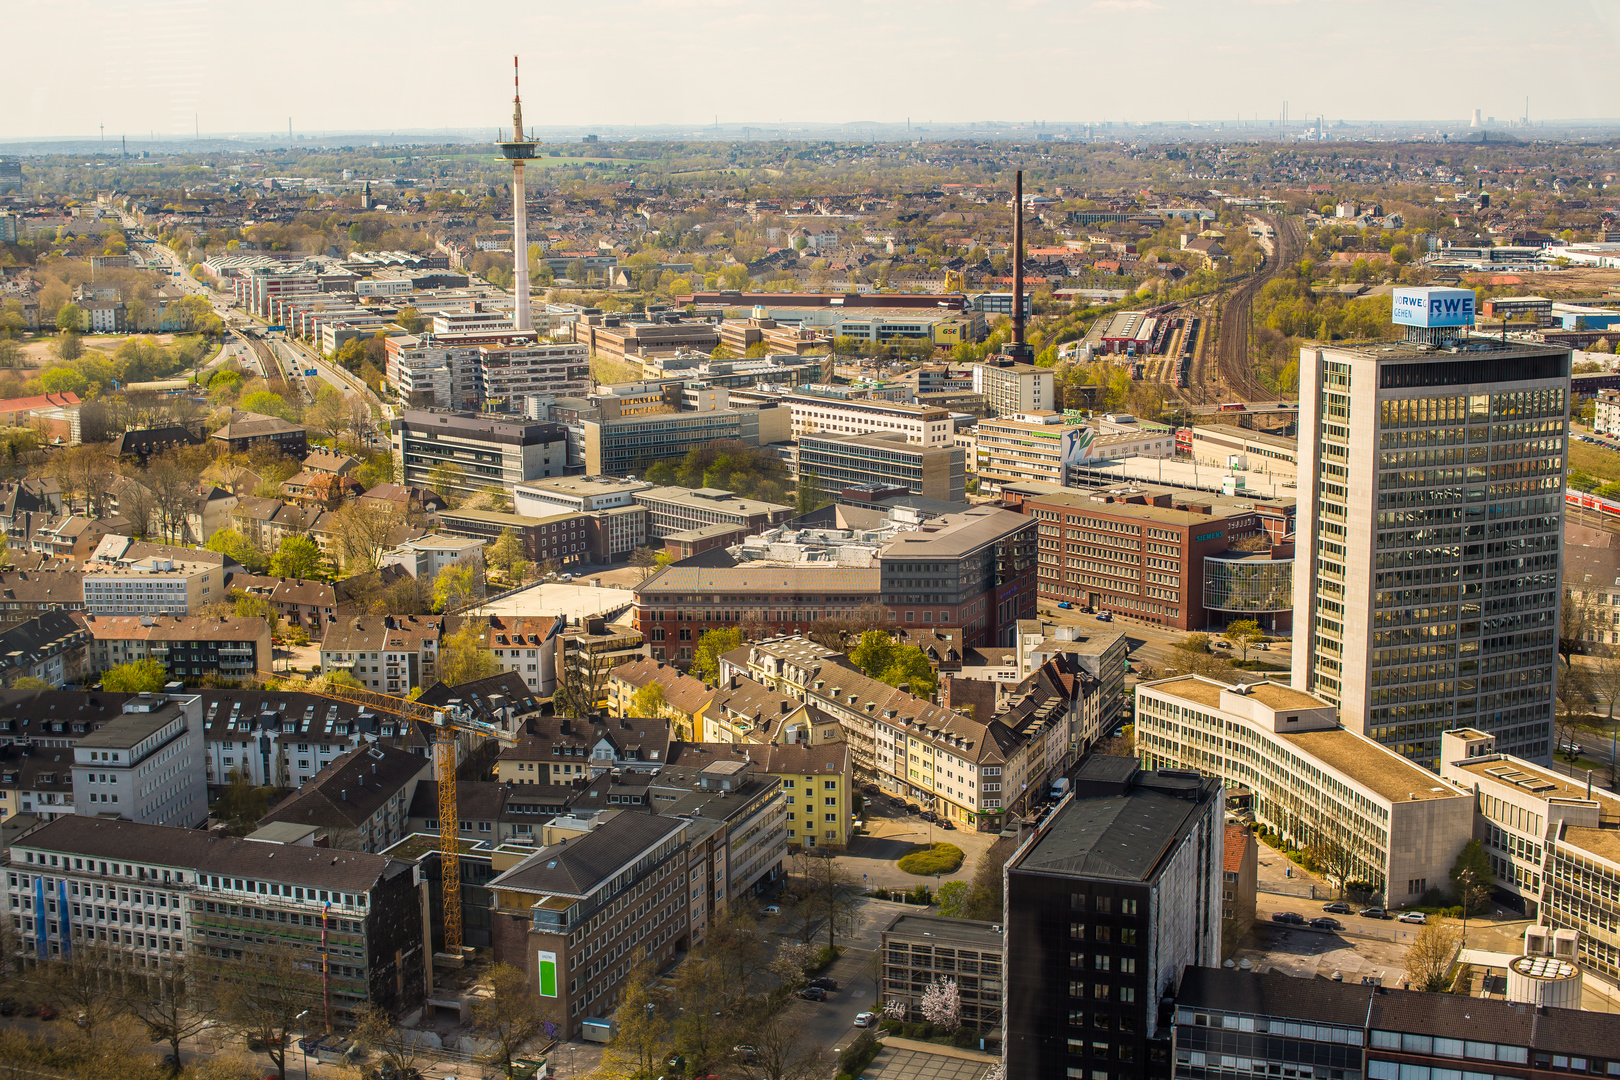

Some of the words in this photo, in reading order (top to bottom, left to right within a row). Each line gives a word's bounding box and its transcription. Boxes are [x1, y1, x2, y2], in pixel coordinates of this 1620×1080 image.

[1394, 295, 1427, 308] VORWEG
[1429, 298, 1473, 313] RWE
[1394, 308, 1412, 318] GEHEN
[1196, 530, 1223, 543] SIEMENS
